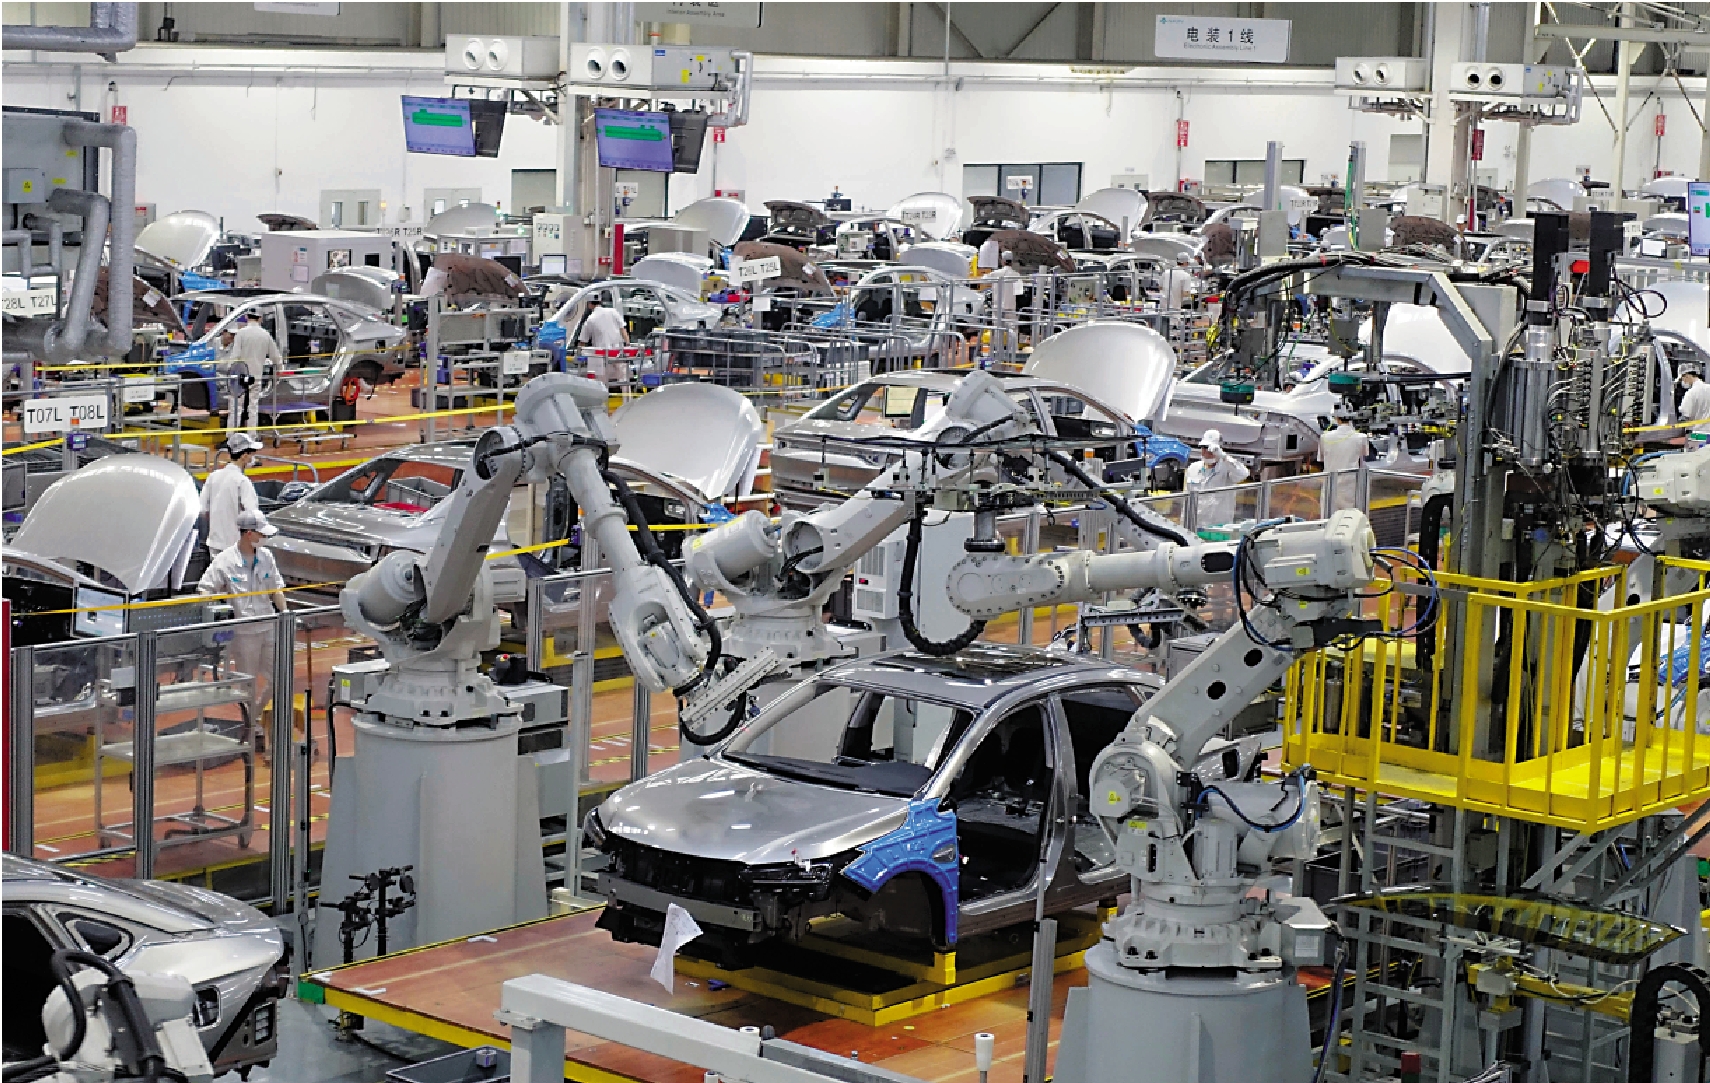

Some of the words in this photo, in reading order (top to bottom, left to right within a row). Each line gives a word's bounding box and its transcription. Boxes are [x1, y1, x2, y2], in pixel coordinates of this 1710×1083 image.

[1187, 27, 1254, 43] 电装1线
[1184, 42, 1211, 50] Electronic
[1212, 44, 1238, 52] Assembly
[2, 298, 25, 309] 28L
[27, 407, 62, 423] T07L
[69, 405, 104, 420] T08L
